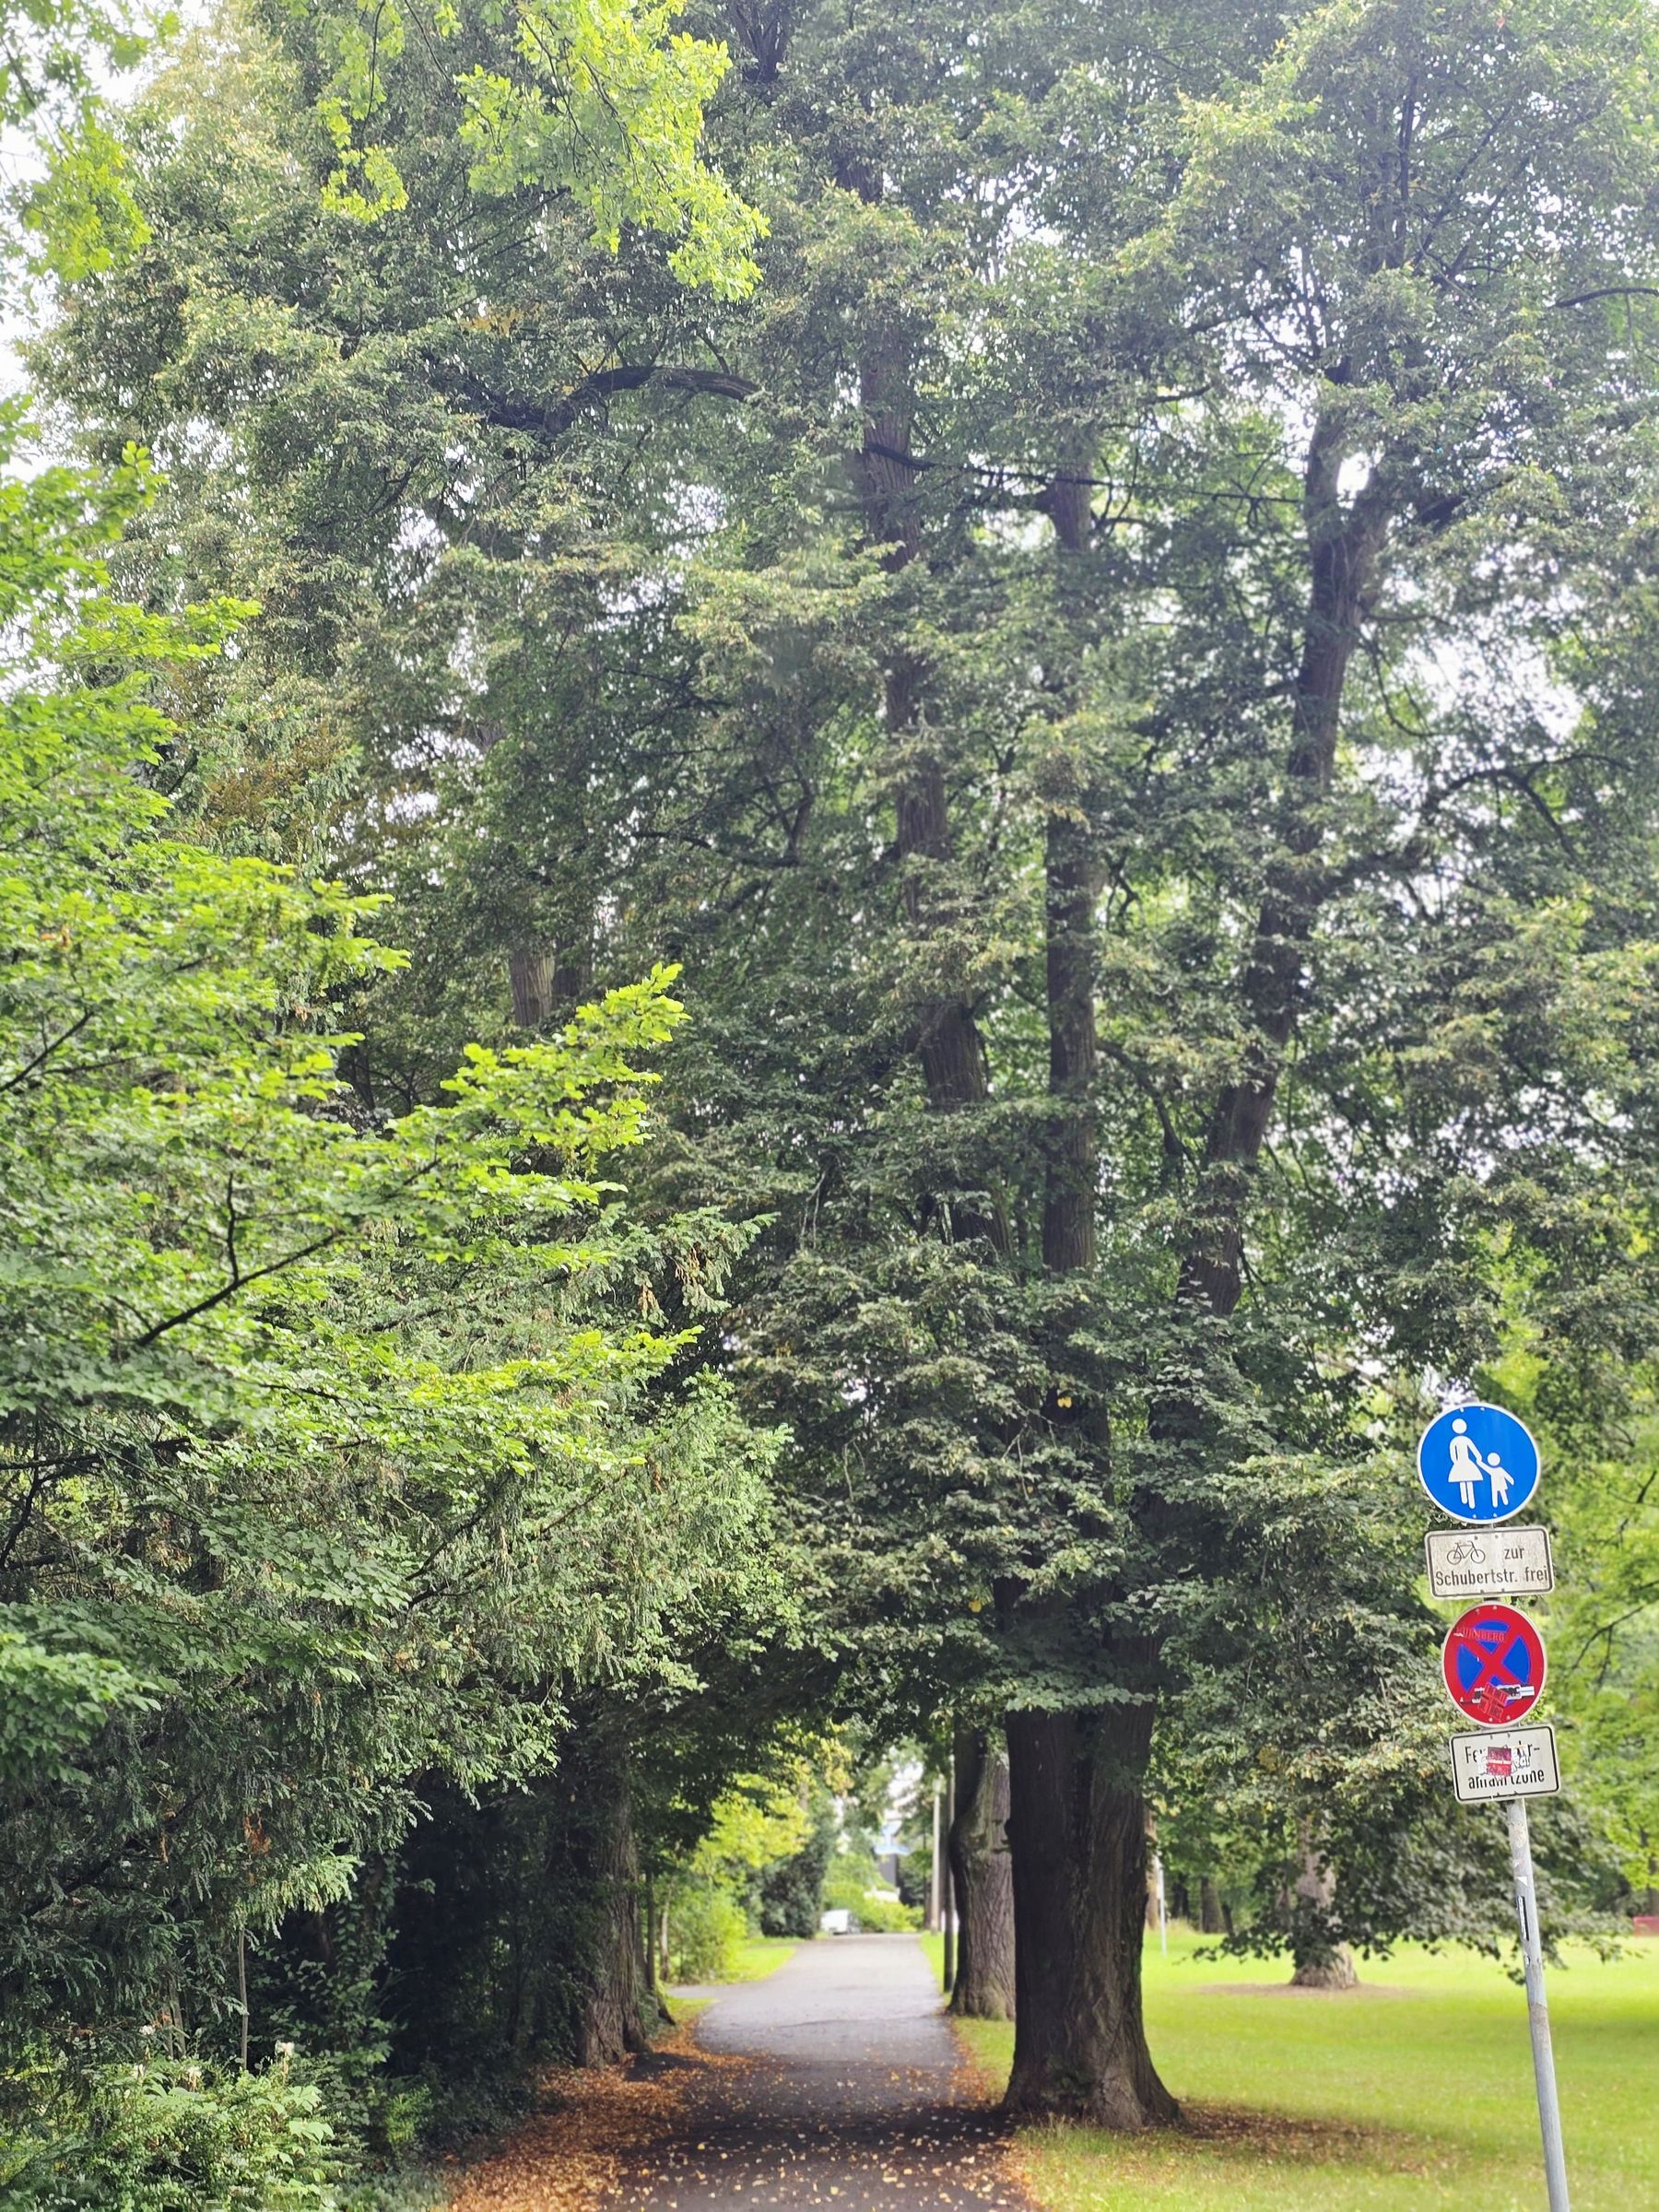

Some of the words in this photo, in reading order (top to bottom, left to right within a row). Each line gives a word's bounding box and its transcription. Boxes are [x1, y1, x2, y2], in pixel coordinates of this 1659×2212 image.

[1504, 1547, 1524, 1559] zur
[1435, 1569, 1518, 1586] Schubertstr.
[1524, 1566, 1548, 1582] frei
